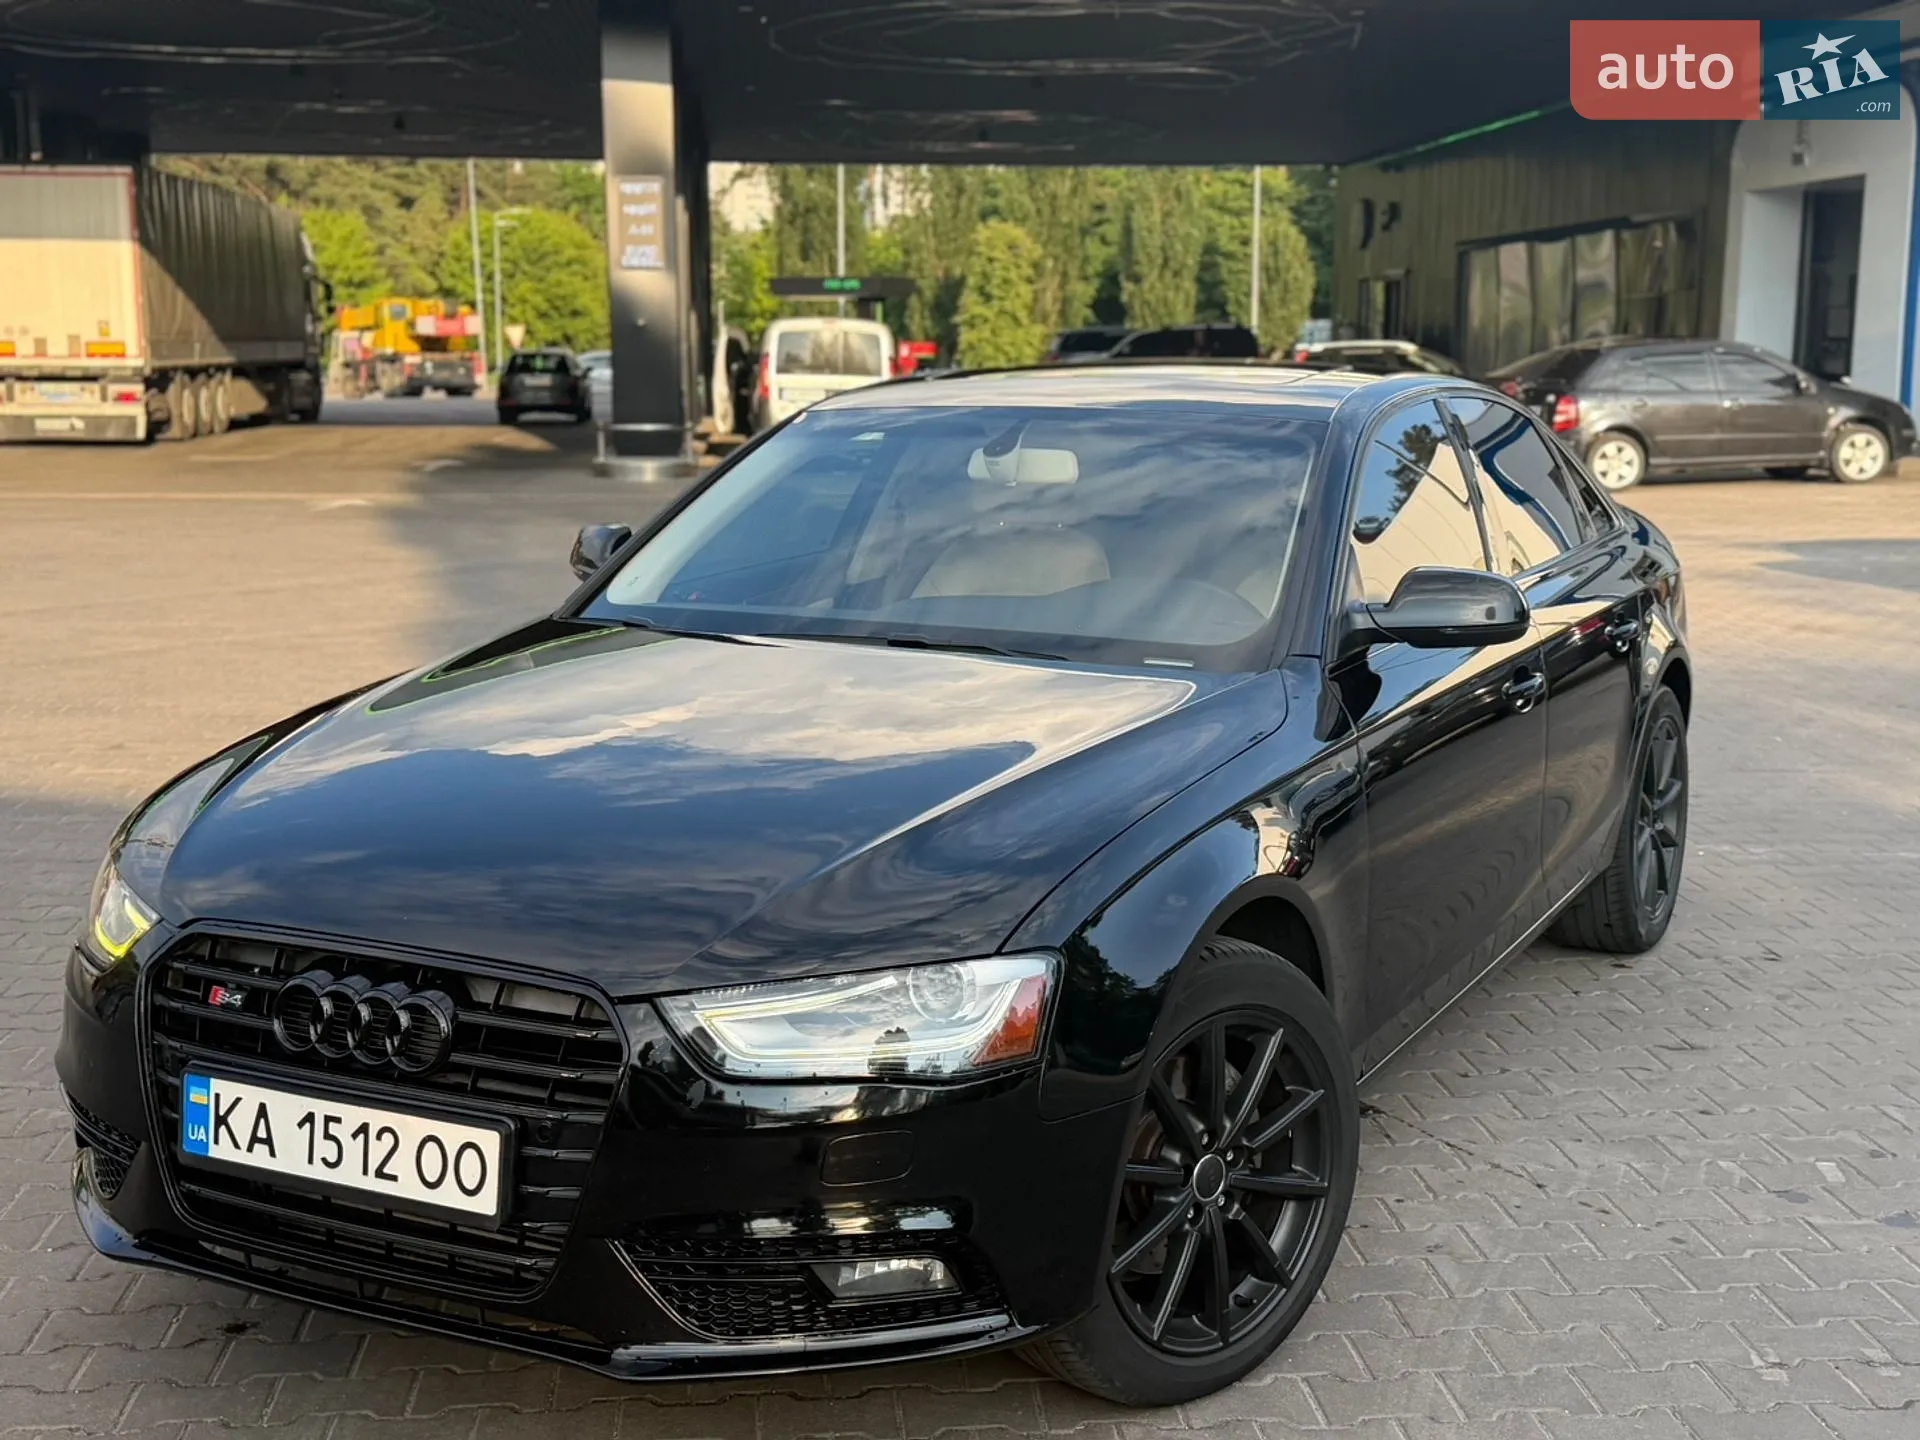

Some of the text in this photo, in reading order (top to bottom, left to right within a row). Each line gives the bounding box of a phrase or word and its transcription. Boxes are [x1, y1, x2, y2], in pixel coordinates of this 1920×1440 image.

[187, 1122, 208, 1144] UA
[213, 1092, 488, 1198] KA 1512 OO
